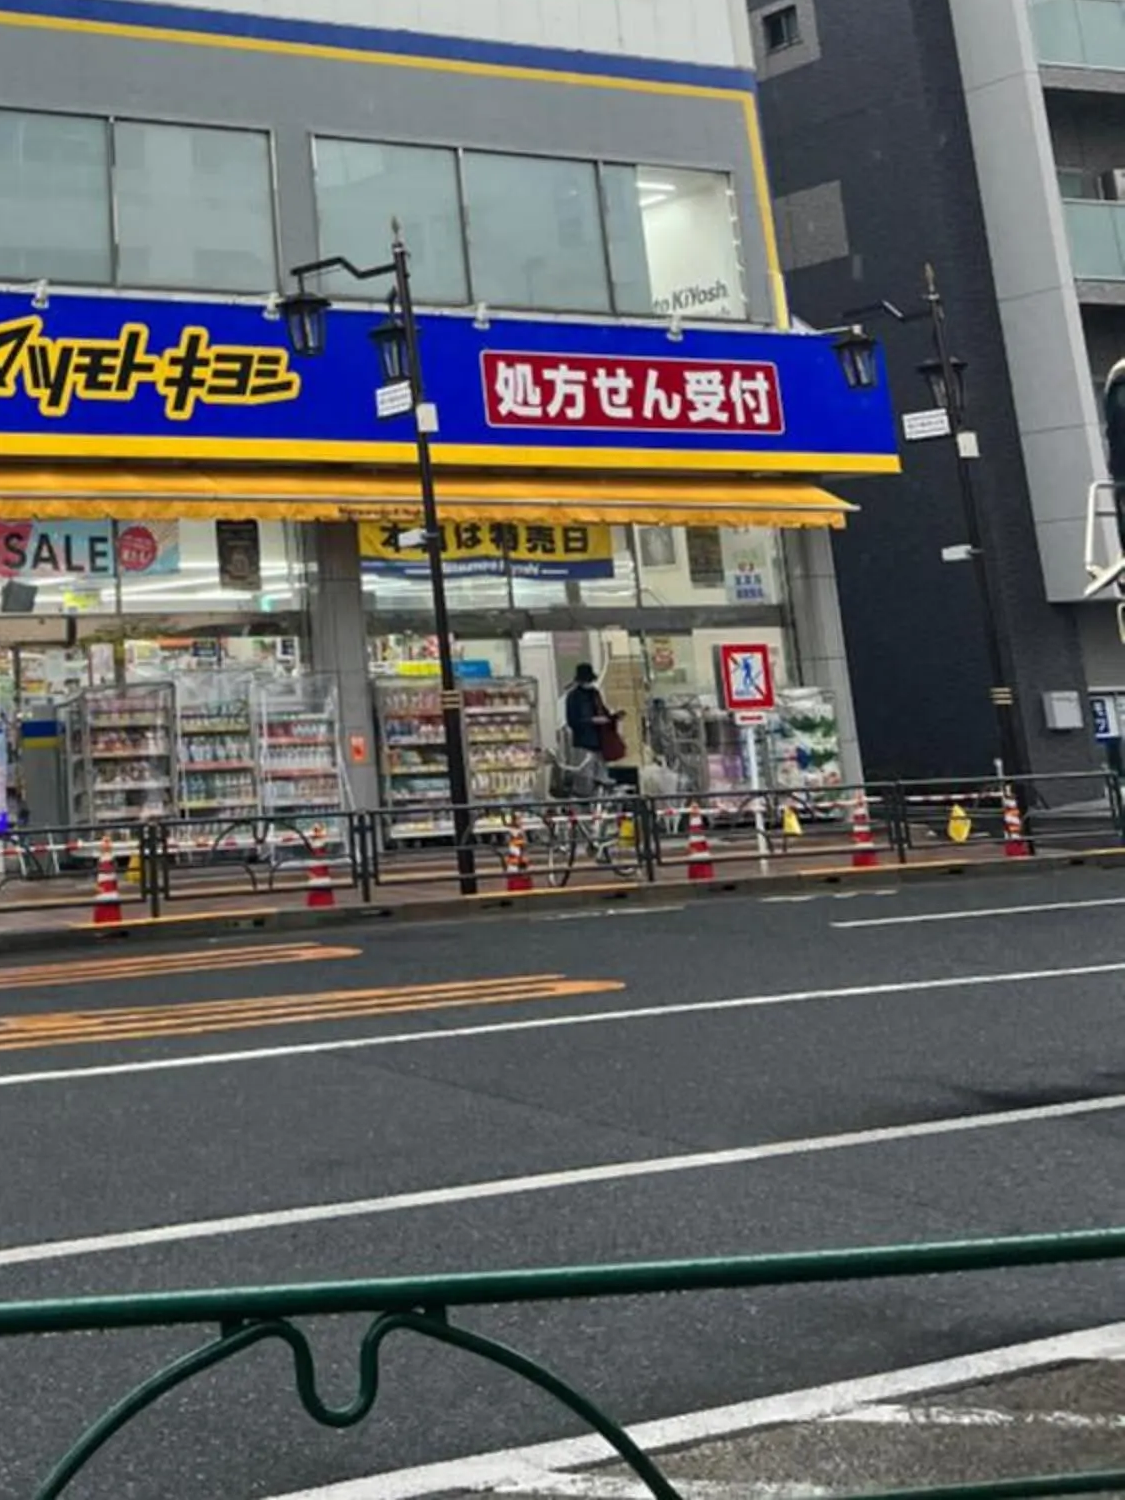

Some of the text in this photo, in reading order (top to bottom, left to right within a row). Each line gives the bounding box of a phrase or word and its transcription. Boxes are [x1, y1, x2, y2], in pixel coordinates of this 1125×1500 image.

[494, 361, 772, 425] 処方せん受付
[2, 531, 109, 574] SALE
